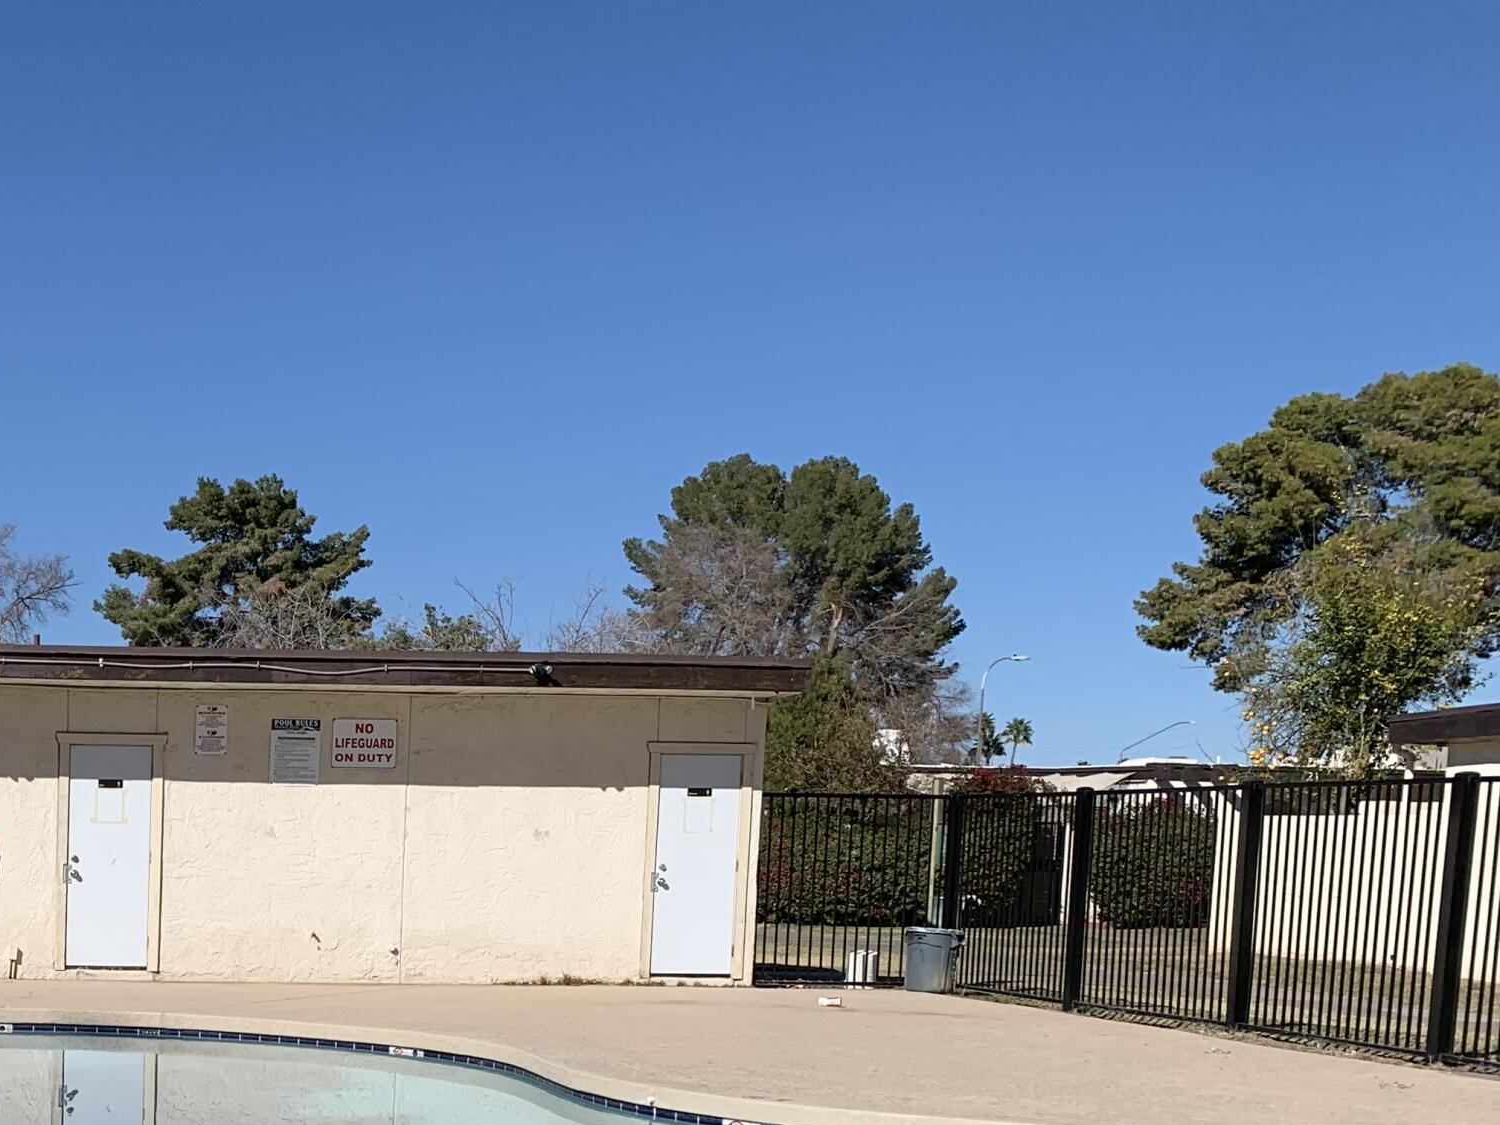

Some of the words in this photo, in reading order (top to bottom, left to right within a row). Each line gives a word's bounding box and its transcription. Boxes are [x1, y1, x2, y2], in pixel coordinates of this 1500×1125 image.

[275, 719, 293, 727] POOL
[295, 719, 319, 727] RULES
[355, 723, 374, 734] NO
[335, 737, 394, 749] LIFEGUARD
[335, 753, 354, 762] ON
[358, 753, 393, 763] DUTY
